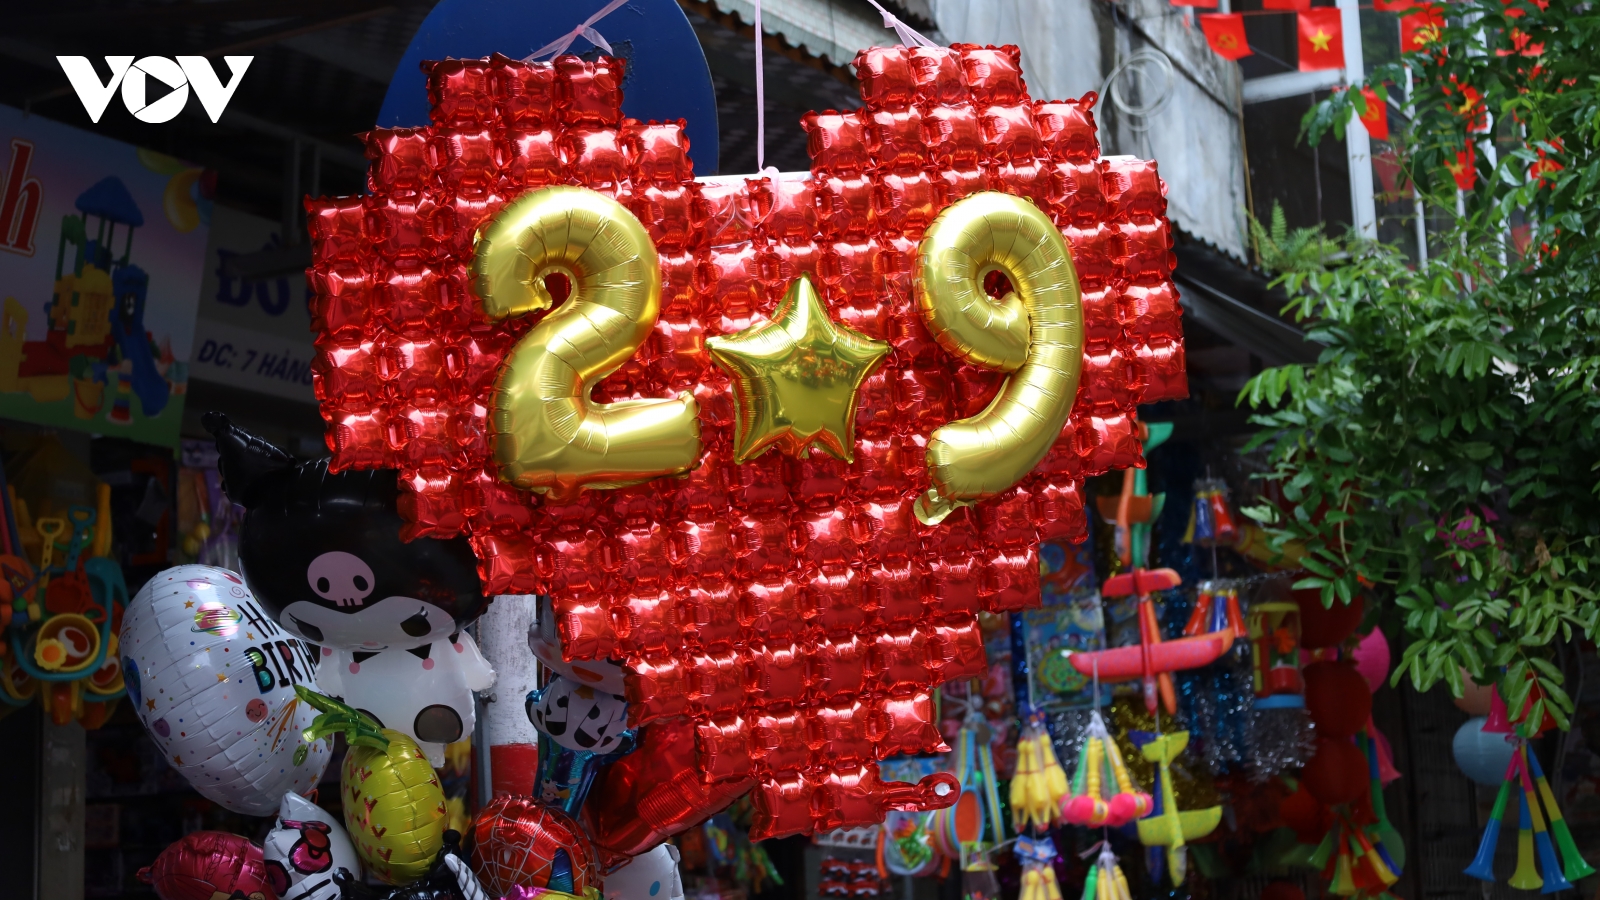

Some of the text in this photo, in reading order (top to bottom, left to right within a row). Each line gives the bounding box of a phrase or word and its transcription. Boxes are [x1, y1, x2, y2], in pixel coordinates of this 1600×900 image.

[241, 350, 258, 371] 7
[467, 185, 1084, 520] 2 9
